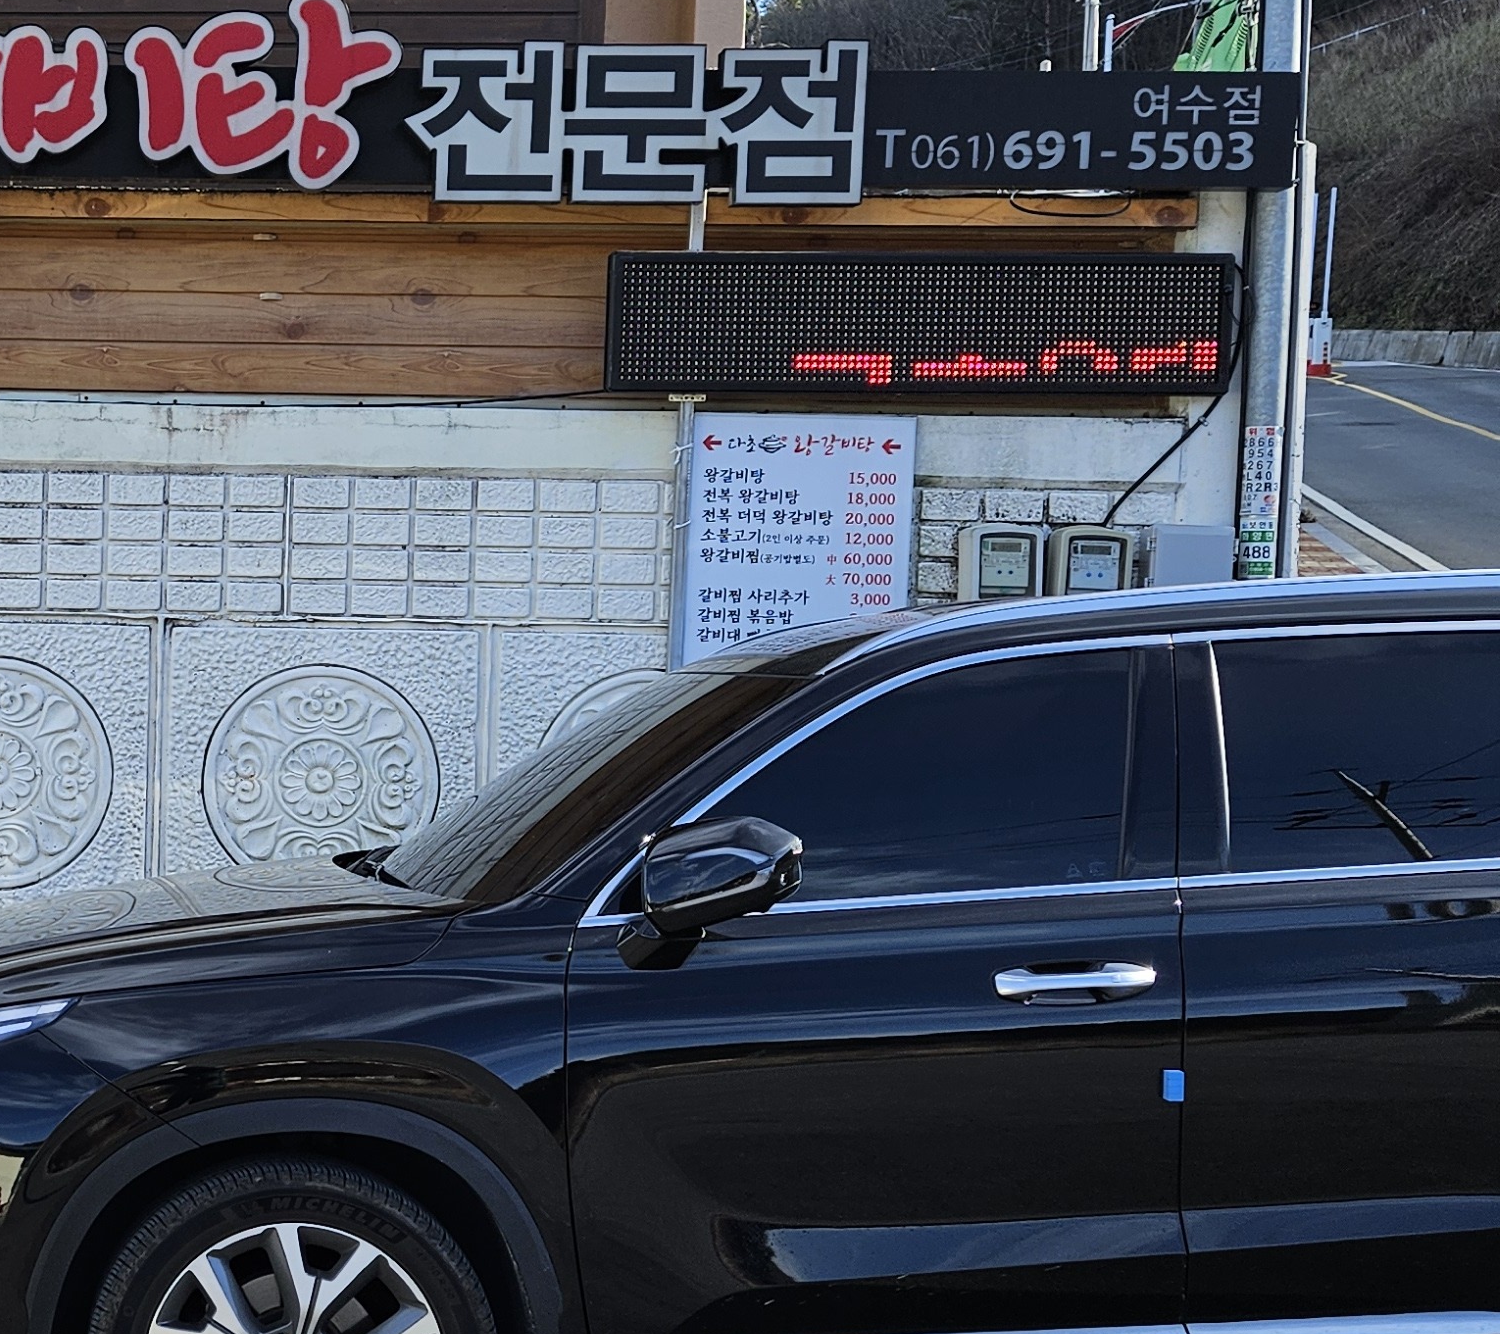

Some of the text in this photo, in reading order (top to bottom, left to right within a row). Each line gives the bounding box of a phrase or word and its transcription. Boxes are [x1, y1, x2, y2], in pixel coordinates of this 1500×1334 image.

[1133, 85, 1262, 125] 여수점
[422, 45, 866, 198] 전문점
[728, 434, 875, 455] 다초 왕갈비탕
[1248, 448, 1274, 459] 954
[703, 467, 897, 487] 왕갈비탕 15,000
[703, 488, 896, 507] 전복 왕갈비탕 18,000
[701, 508, 895, 527] 전복 더덕 왕갈비탕 20,000
[784, 534, 803, 544] 이상
[805, 534, 830, 545] 주문)
[845, 532, 894, 547] 12,000
[827, 554, 837, 565] 中
[843, 553, 893, 568] 60,000
[1243, 545, 1271, 559] 488
[825, 573, 892, 588] 大 70,000
[698, 587, 891, 608] 갈비찜 사리추가 3,000
[697, 607, 794, 625] 갈비찜 볶음밥
[696, 627, 741, 643] 갈비대
[269, 1196, 402, 1241] MICHELIN
